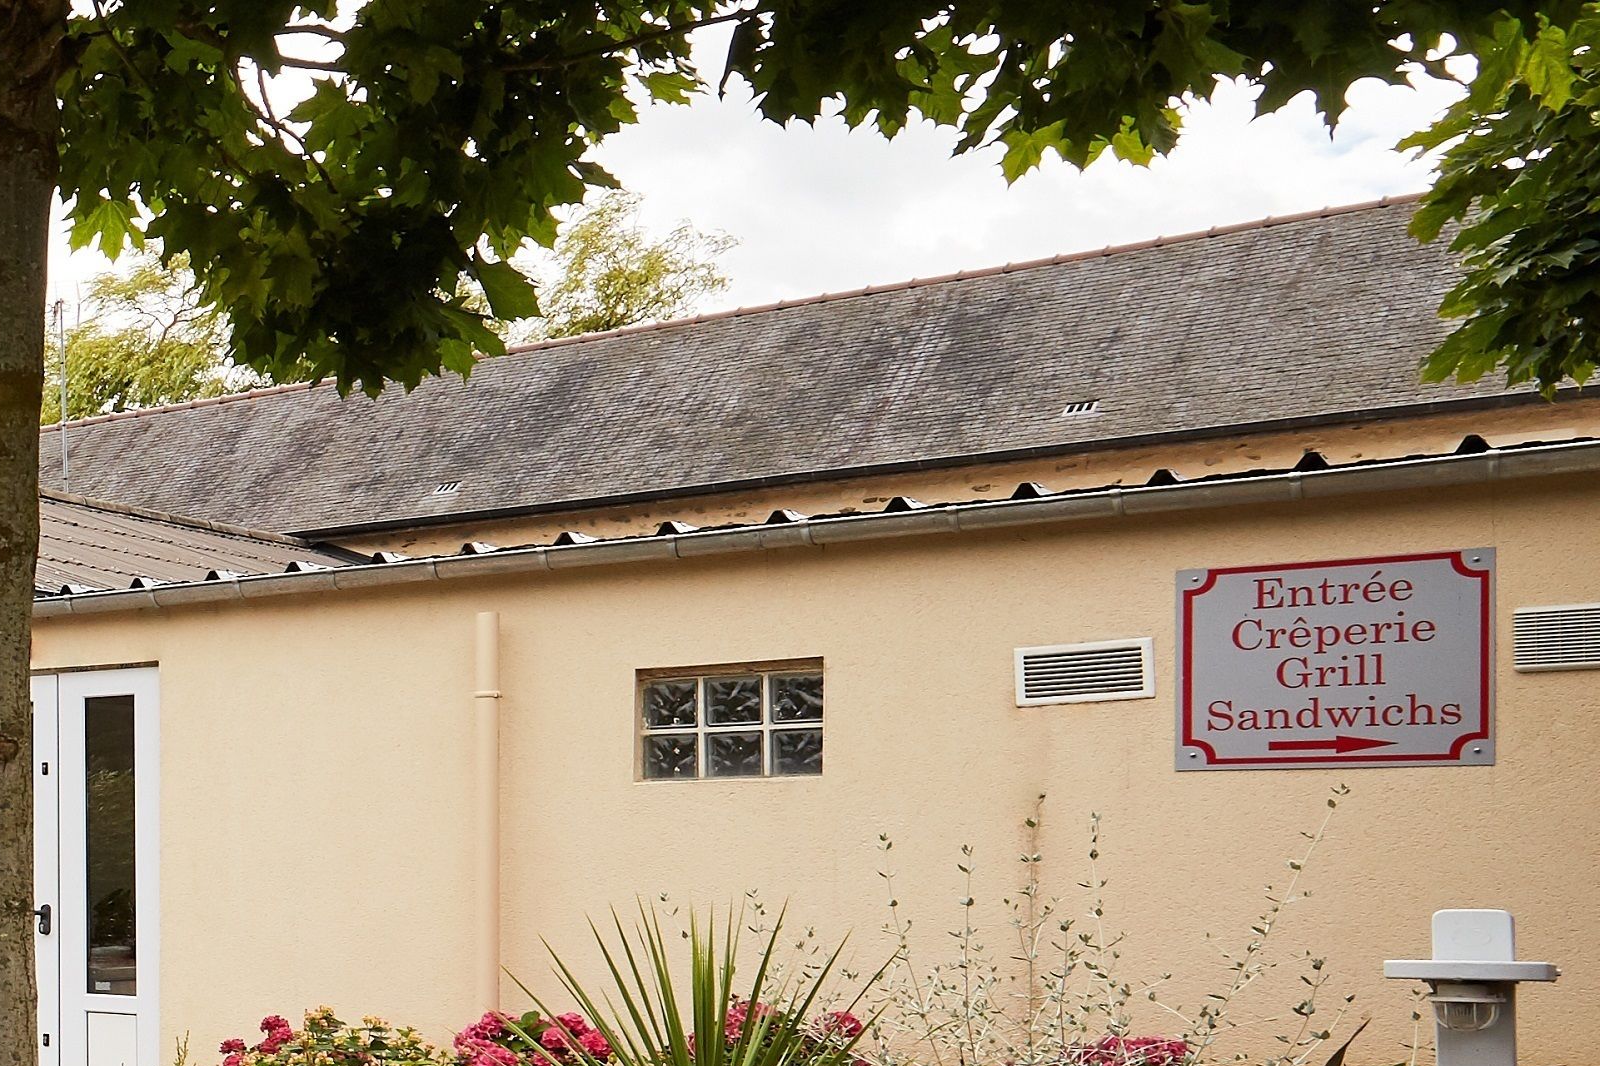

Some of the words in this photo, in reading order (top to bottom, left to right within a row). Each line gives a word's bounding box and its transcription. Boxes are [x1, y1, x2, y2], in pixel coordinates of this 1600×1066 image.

[1252, 571, 1413, 610] Entrée
[1231, 611, 1436, 654] Crêperie
[1276, 653, 1387, 689] Grill
[1207, 693, 1463, 732] Sandwichs
